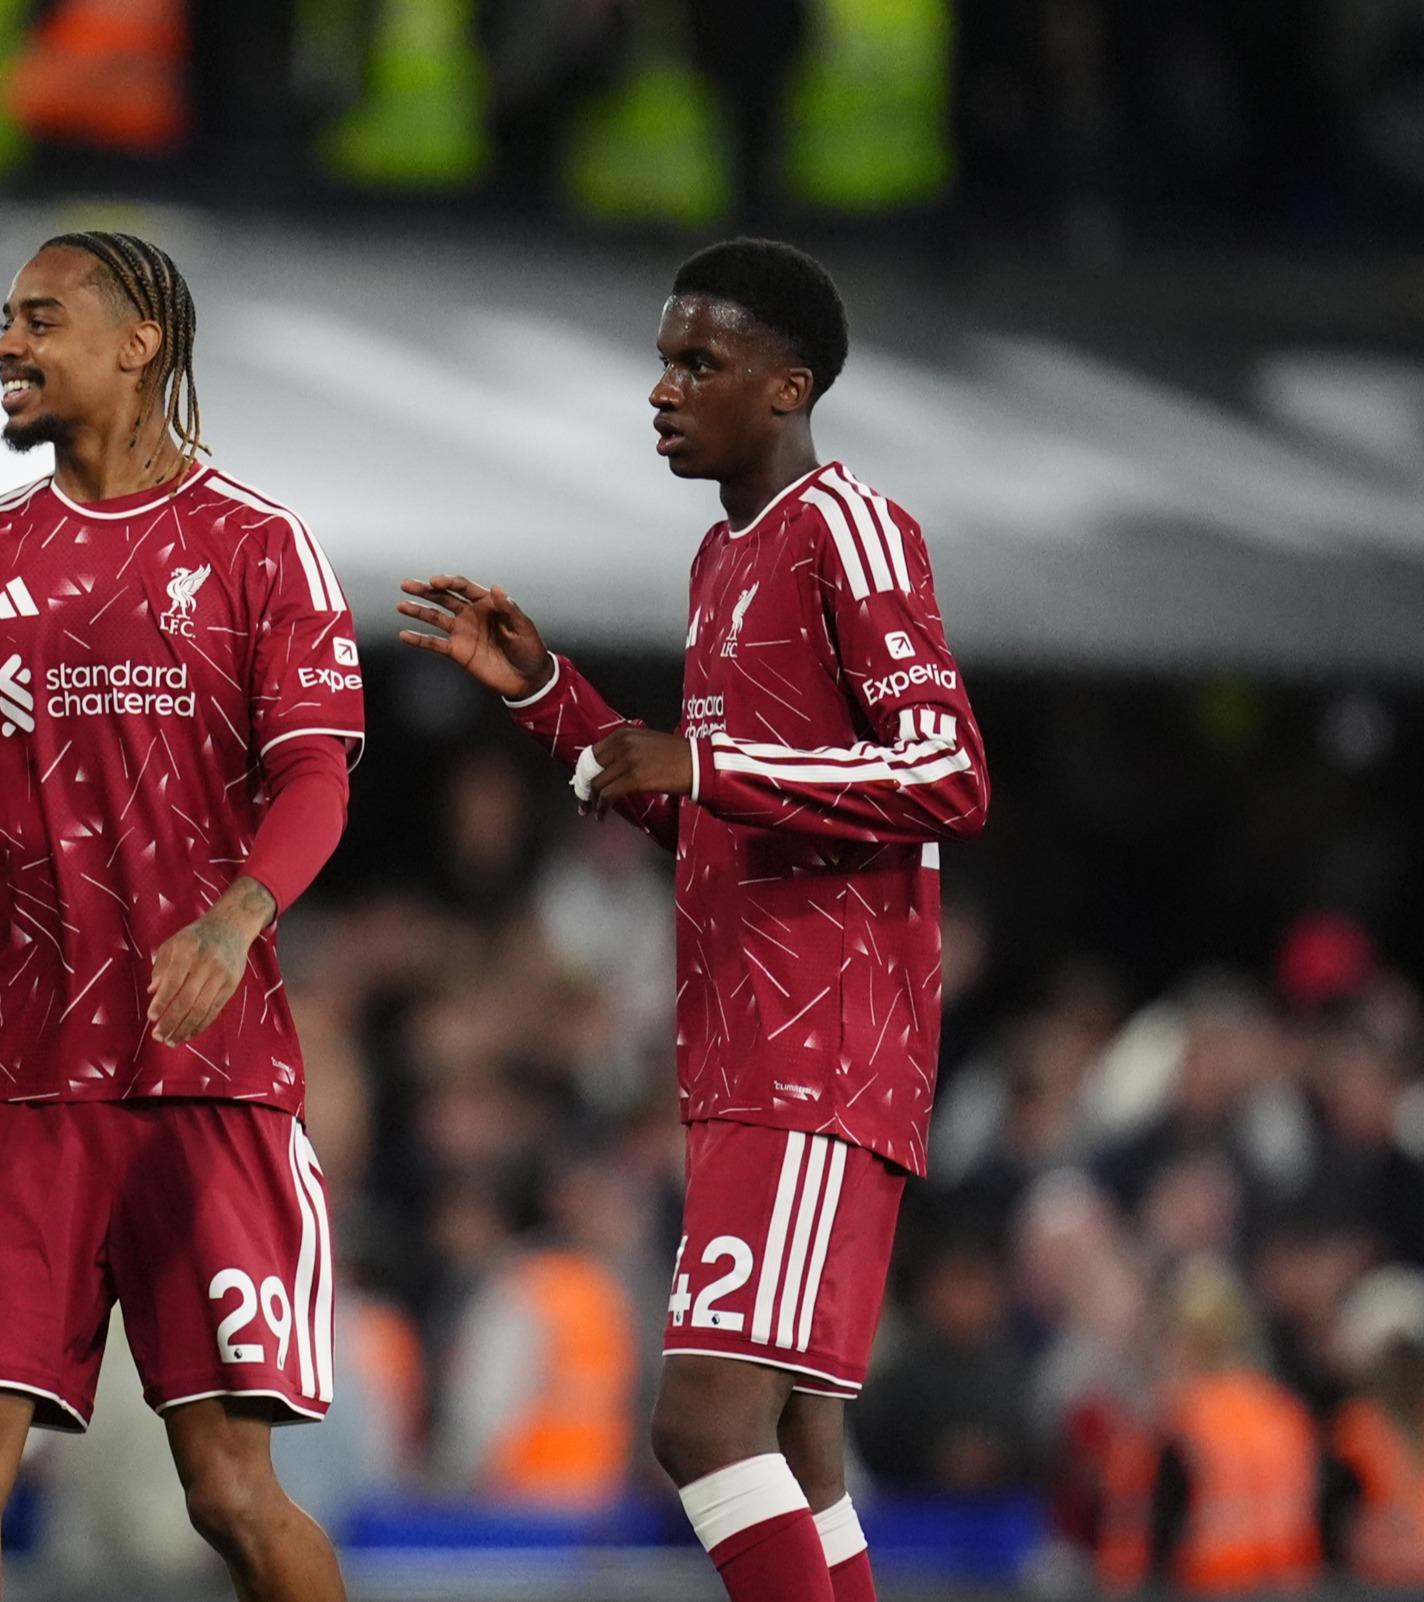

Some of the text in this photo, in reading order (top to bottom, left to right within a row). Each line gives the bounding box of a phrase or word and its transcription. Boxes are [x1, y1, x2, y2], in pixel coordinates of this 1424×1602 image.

[46, 660, 187, 690] standard
[47, 688, 196, 718] chartered
[668, 1235, 754, 1332] 42
[209, 1268, 292, 1371] 29
